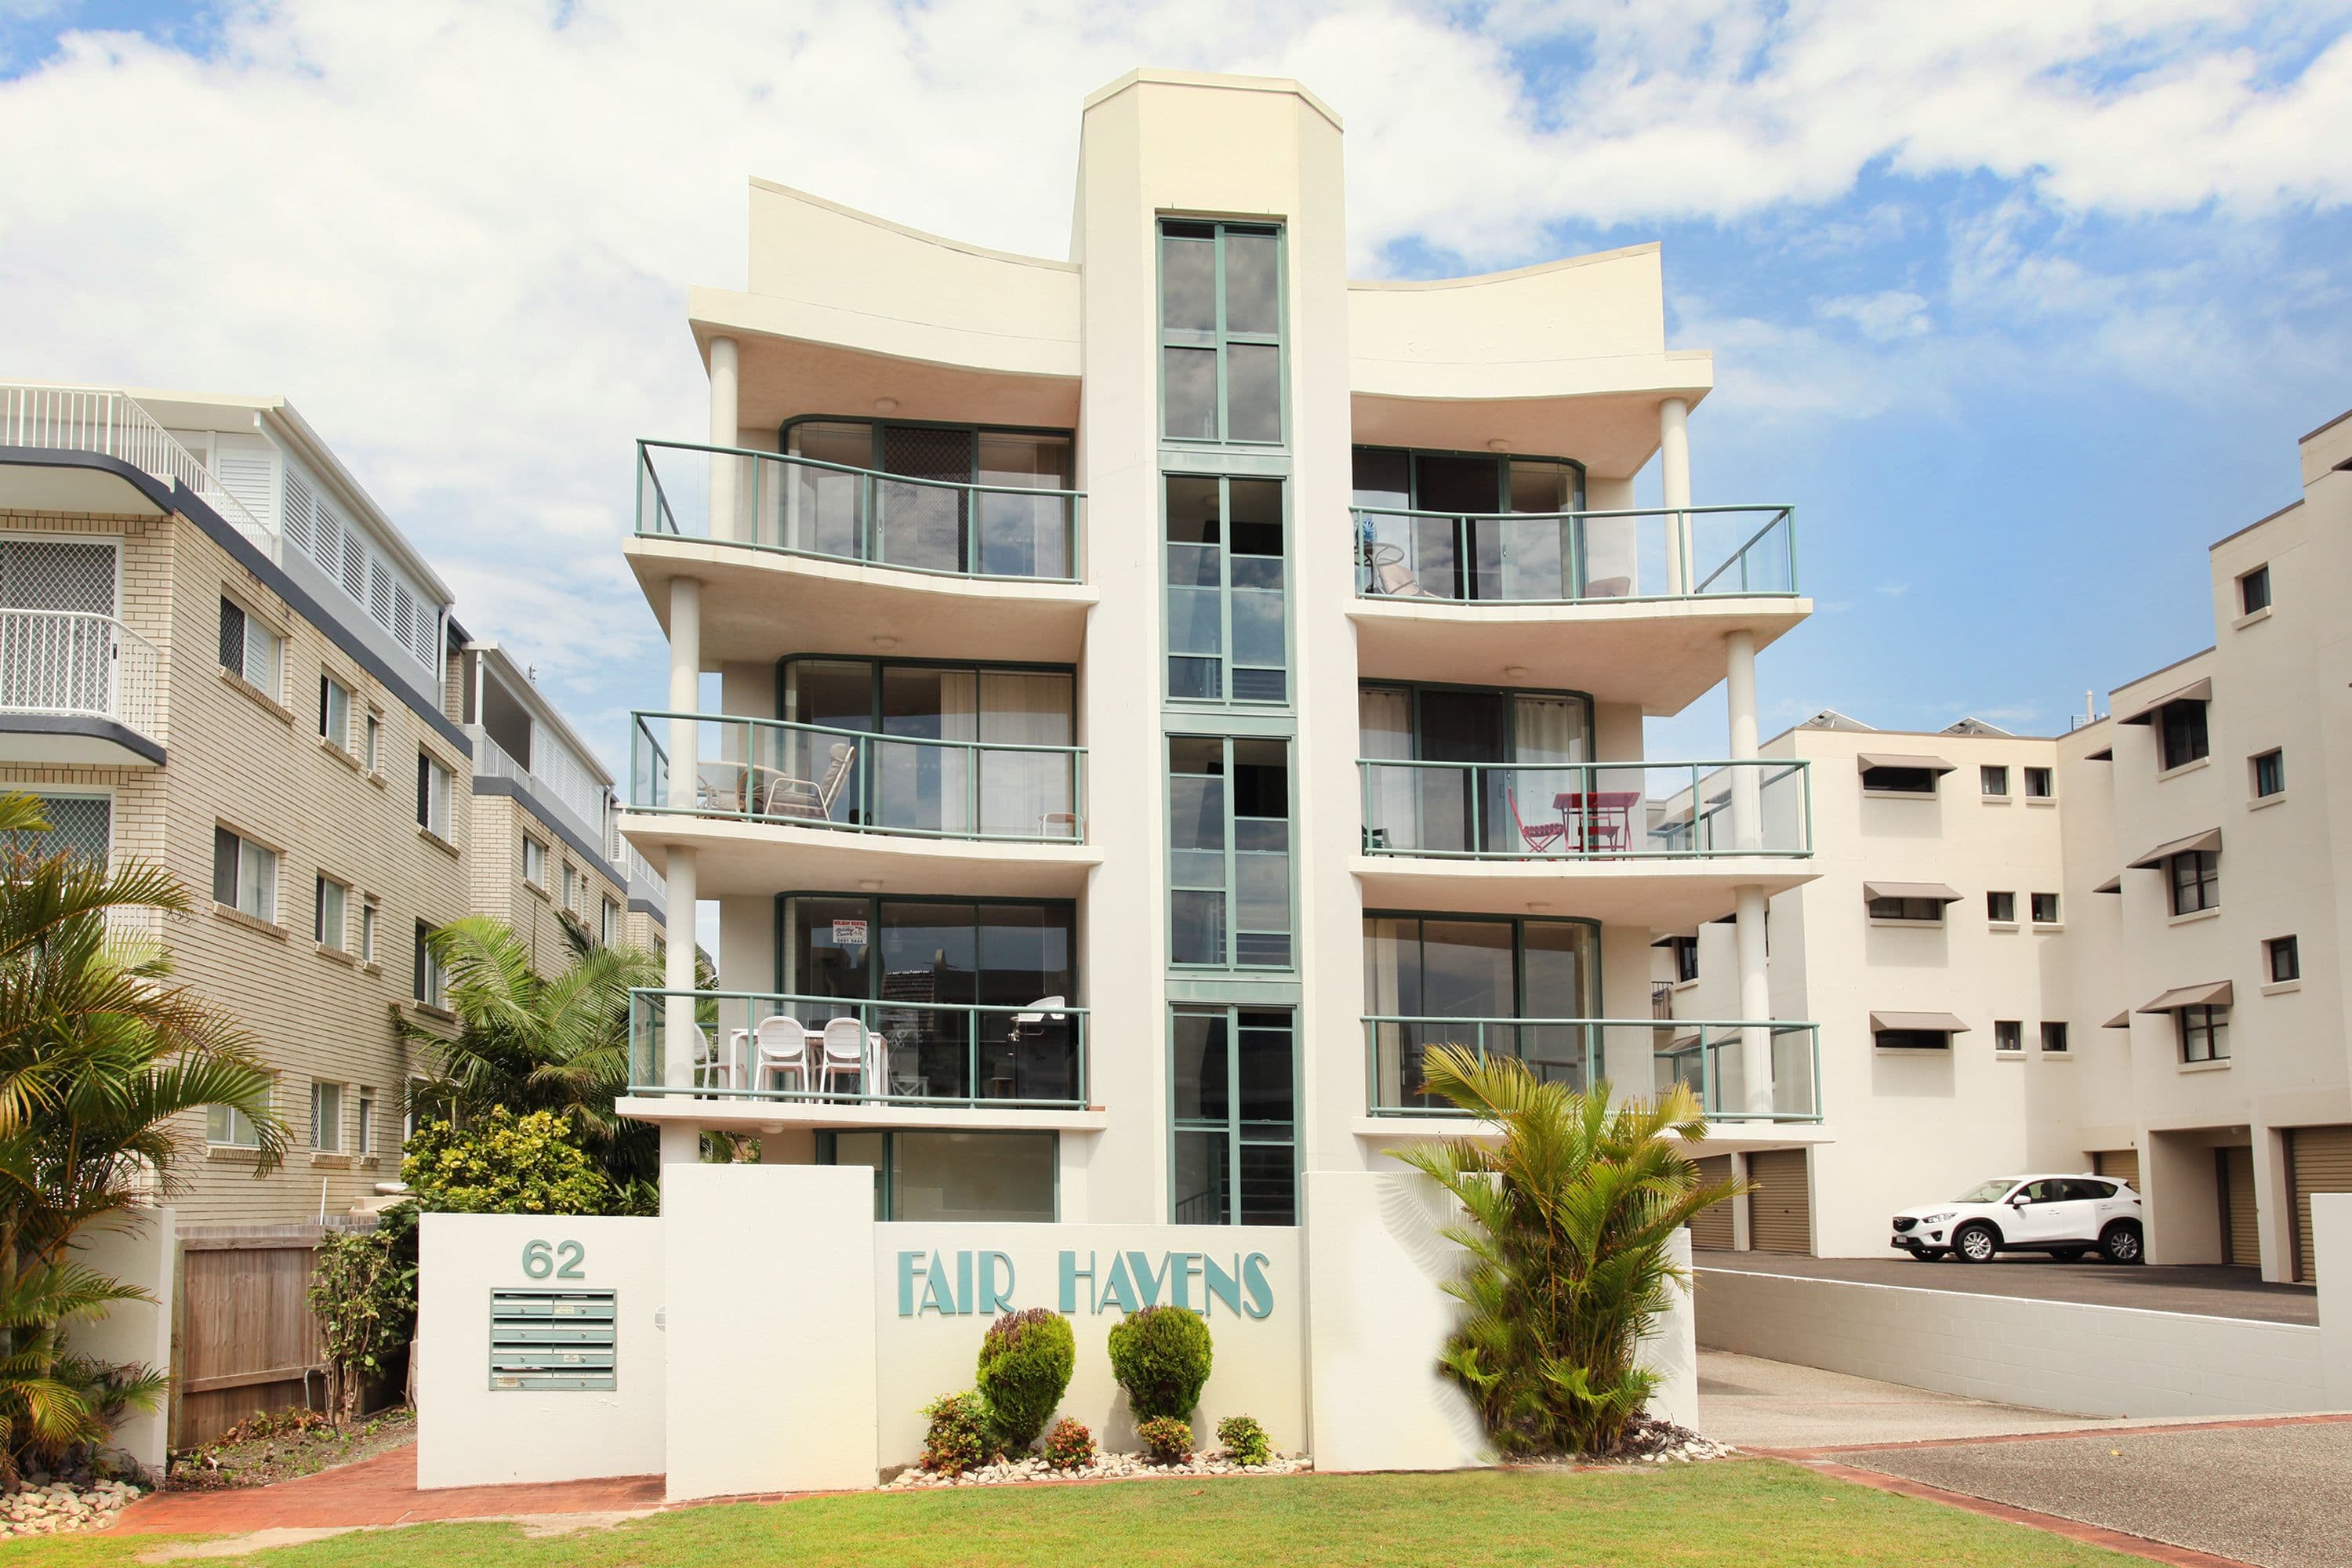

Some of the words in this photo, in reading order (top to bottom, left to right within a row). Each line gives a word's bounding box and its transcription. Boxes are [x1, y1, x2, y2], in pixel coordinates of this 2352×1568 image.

[522, 1239, 585, 1279] 62
[897, 1248, 1016, 1316] FAIR
[1058, 1249, 1274, 1319] HAVENS
